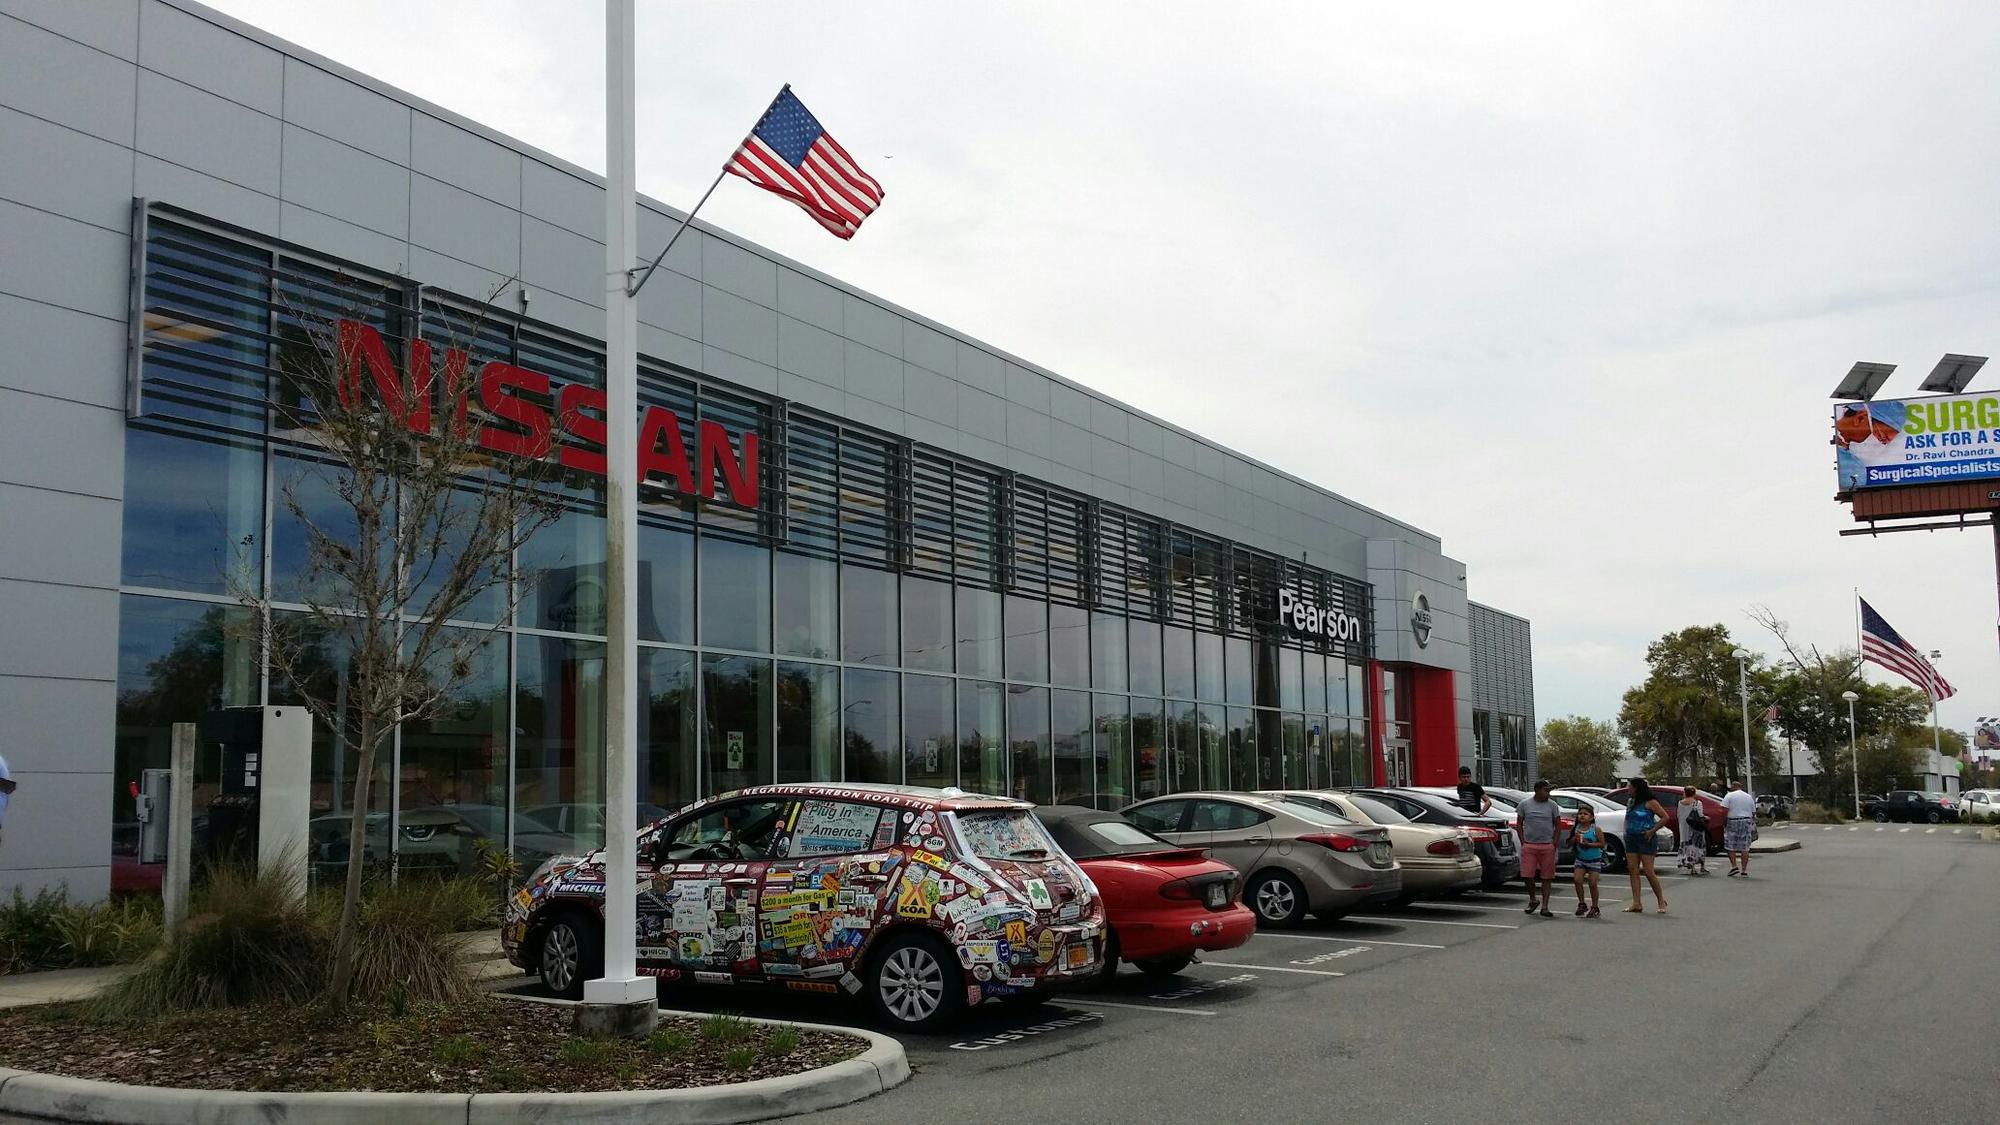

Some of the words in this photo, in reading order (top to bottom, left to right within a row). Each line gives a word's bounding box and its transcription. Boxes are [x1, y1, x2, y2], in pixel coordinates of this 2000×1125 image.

[338, 319, 758, 508] NISSAN
[1904, 398, 2000, 435] SURG
[1905, 434, 1936, 449] ASK
[1942, 431, 1972, 446] FOR
[1977, 430, 1988, 443] A
[1905, 453, 1920, 461] Dr.
[1923, 450, 1946, 459] Ravi
[1949, 448, 1994, 458] Chandra
[1869, 461, 2000, 482] SurgicalSpecialists
[1278, 588, 1360, 642] Pearson
[743, 787, 804, 796] NEGATIVE
[809, 787, 860, 799] CARBON
[863, 792, 901, 805] ROAD
[905, 799, 934, 811] TRIP
[809, 805, 837, 819] Plug
[840, 807, 852, 817] In
[810, 824, 863, 838] America
[926, 838, 944, 847] SGM
[559, 884, 606, 893] MICHELI
[813, 892, 826, 900] Gas
[793, 912, 806, 920] OR
[899, 906, 927, 914] KOA
[949, 1011, 1105, 1051] Customer
